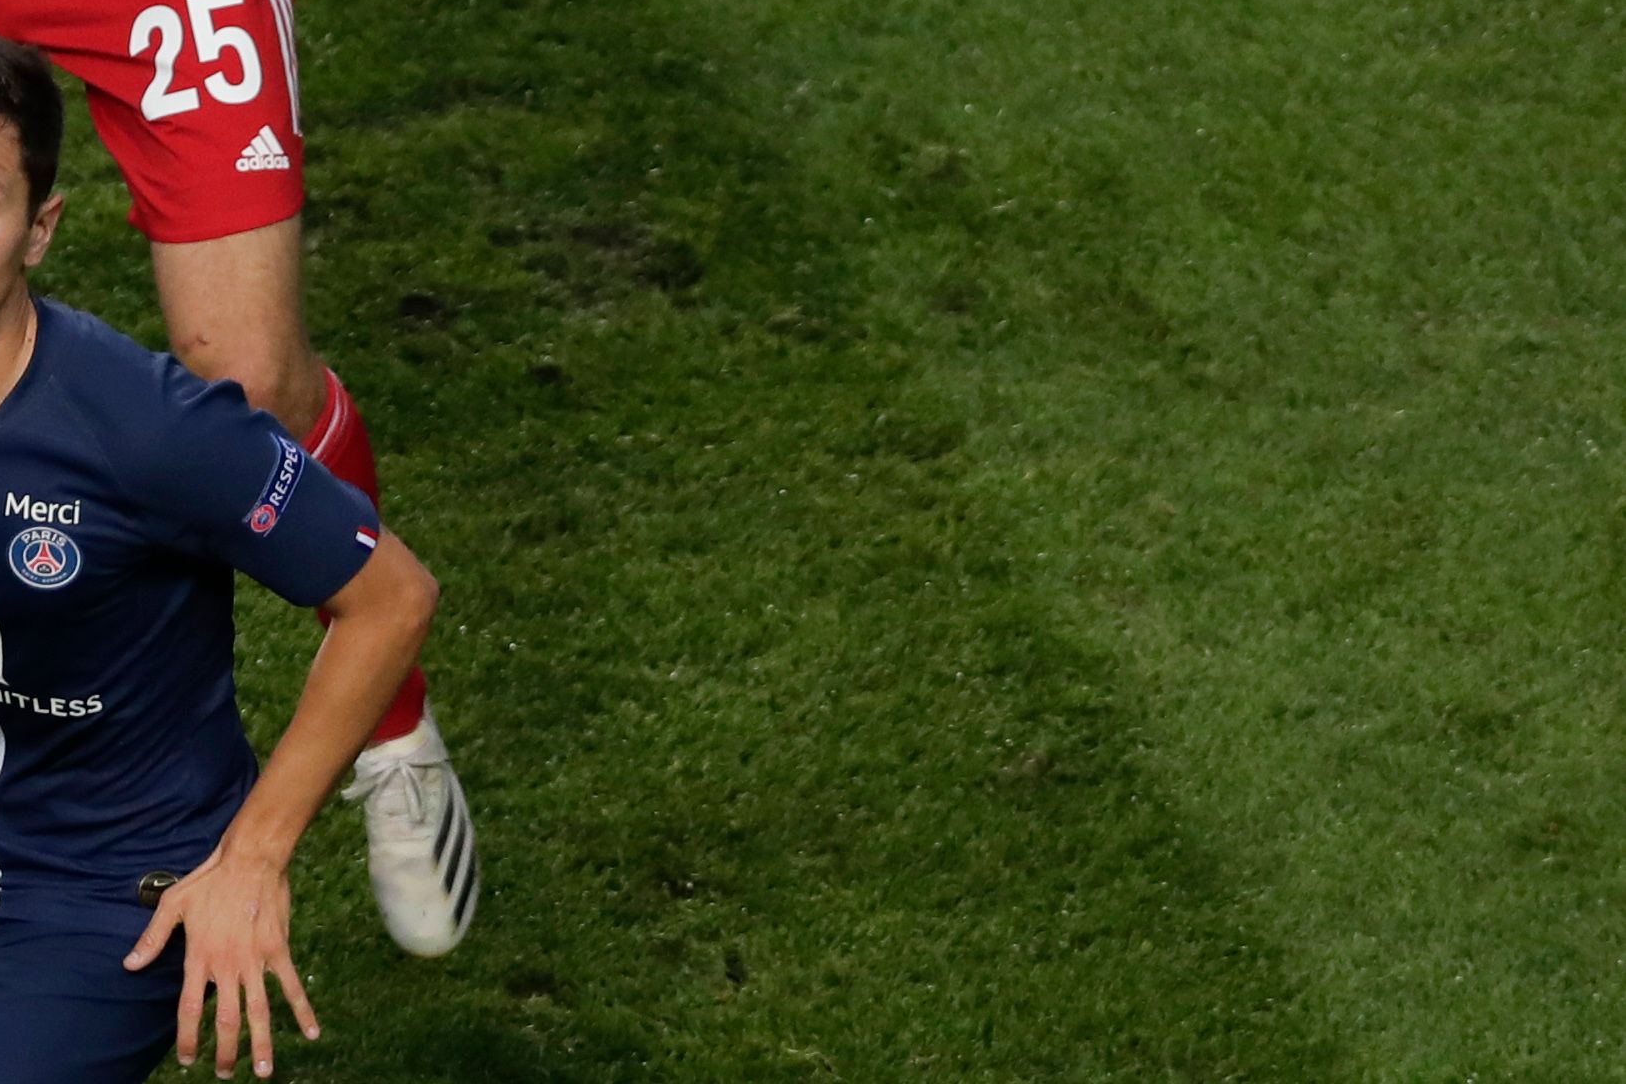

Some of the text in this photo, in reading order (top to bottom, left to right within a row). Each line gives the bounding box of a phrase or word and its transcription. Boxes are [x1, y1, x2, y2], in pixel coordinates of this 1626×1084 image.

[235, 154, 290, 172] adidas
[268, 436, 299, 507] RESPEC
[5, 492, 80, 524] Merci
[21, 530, 67, 547] PARIS
